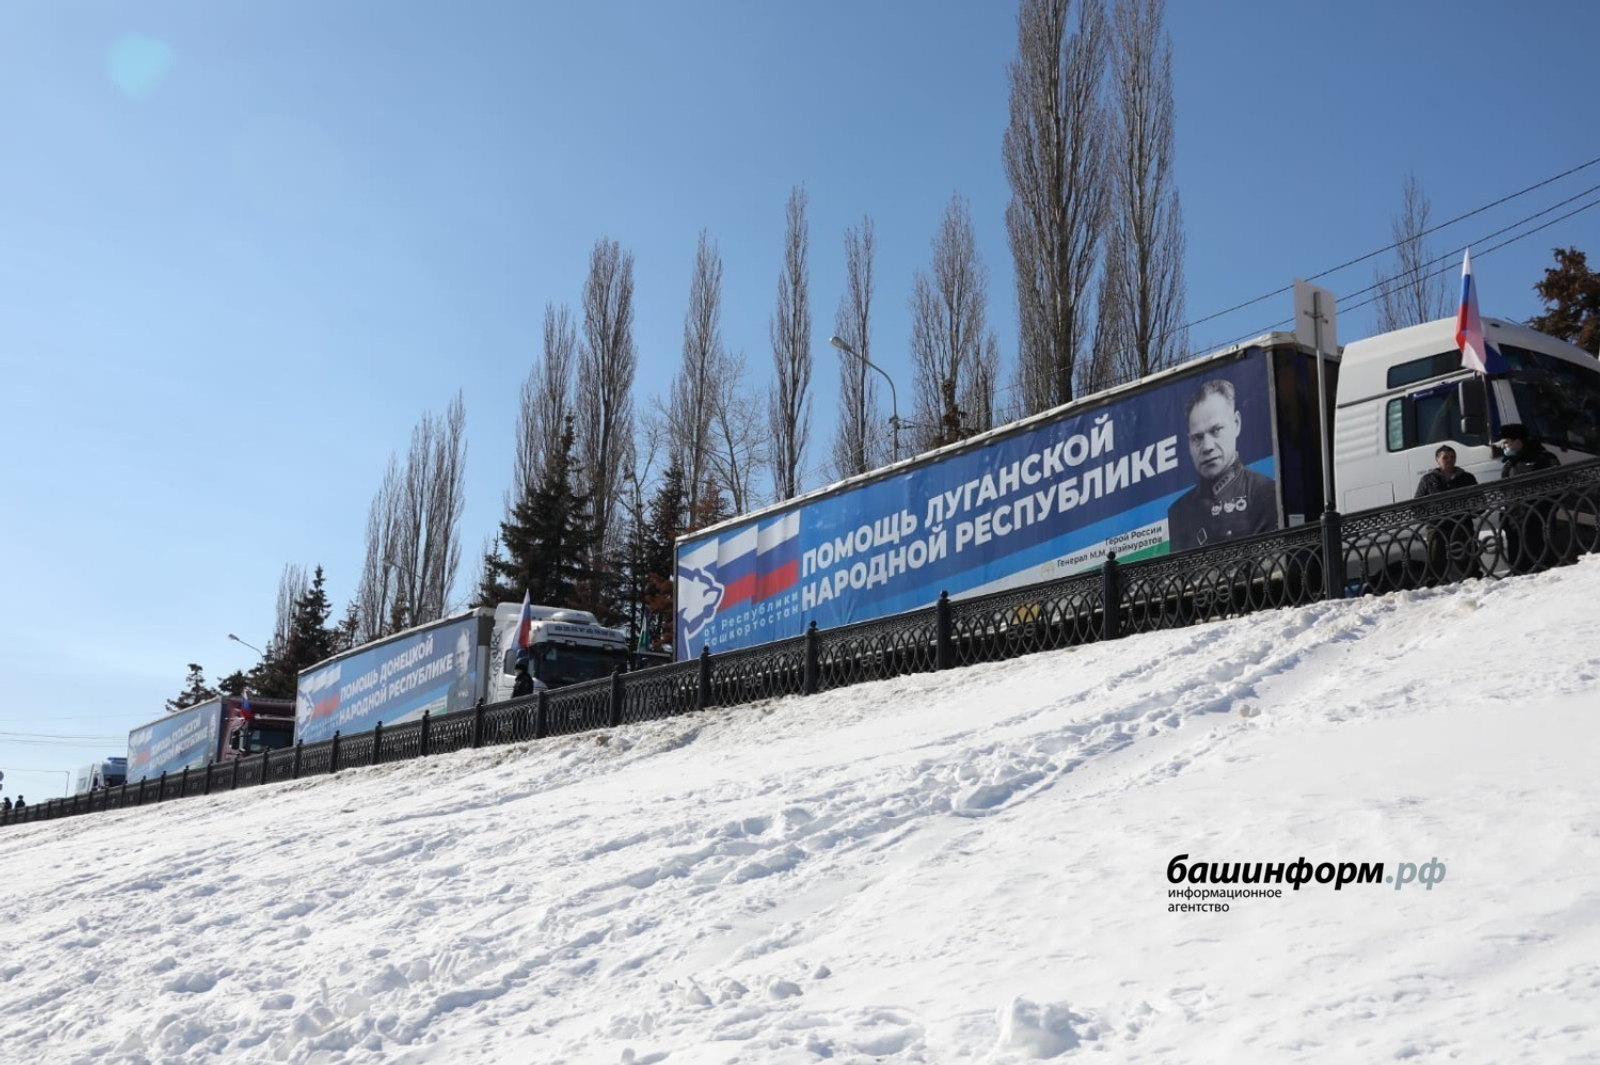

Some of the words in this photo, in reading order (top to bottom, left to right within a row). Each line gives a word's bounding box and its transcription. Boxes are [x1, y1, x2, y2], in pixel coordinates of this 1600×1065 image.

[802, 522, 947, 611] НАРОДНОЙ
[956, 435, 1179, 552] РЕСПУБЛИКЕ
[803, 509, 918, 577] ПОМОЩЬ
[925, 413, 1114, 528] ЛУГАНСКОЙ
[1057, 555, 1088, 568] Генерал
[1110, 536, 1163, 554] Шаймуратов
[1105, 533, 1129, 546] Герой
[1131, 525, 1162, 539] России
[704, 625, 716, 637] от
[721, 591, 799, 630] Республики
[704, 604, 799, 647] Башкортостан
[339, 683, 387, 725] НАРОДНОЙ
[388, 653, 453, 700] РЕСПУБЛИКЕ
[340, 669, 379, 703] ПОМОЩЬ
[380, 635, 433, 684] ДОНЕЦКОЙ
